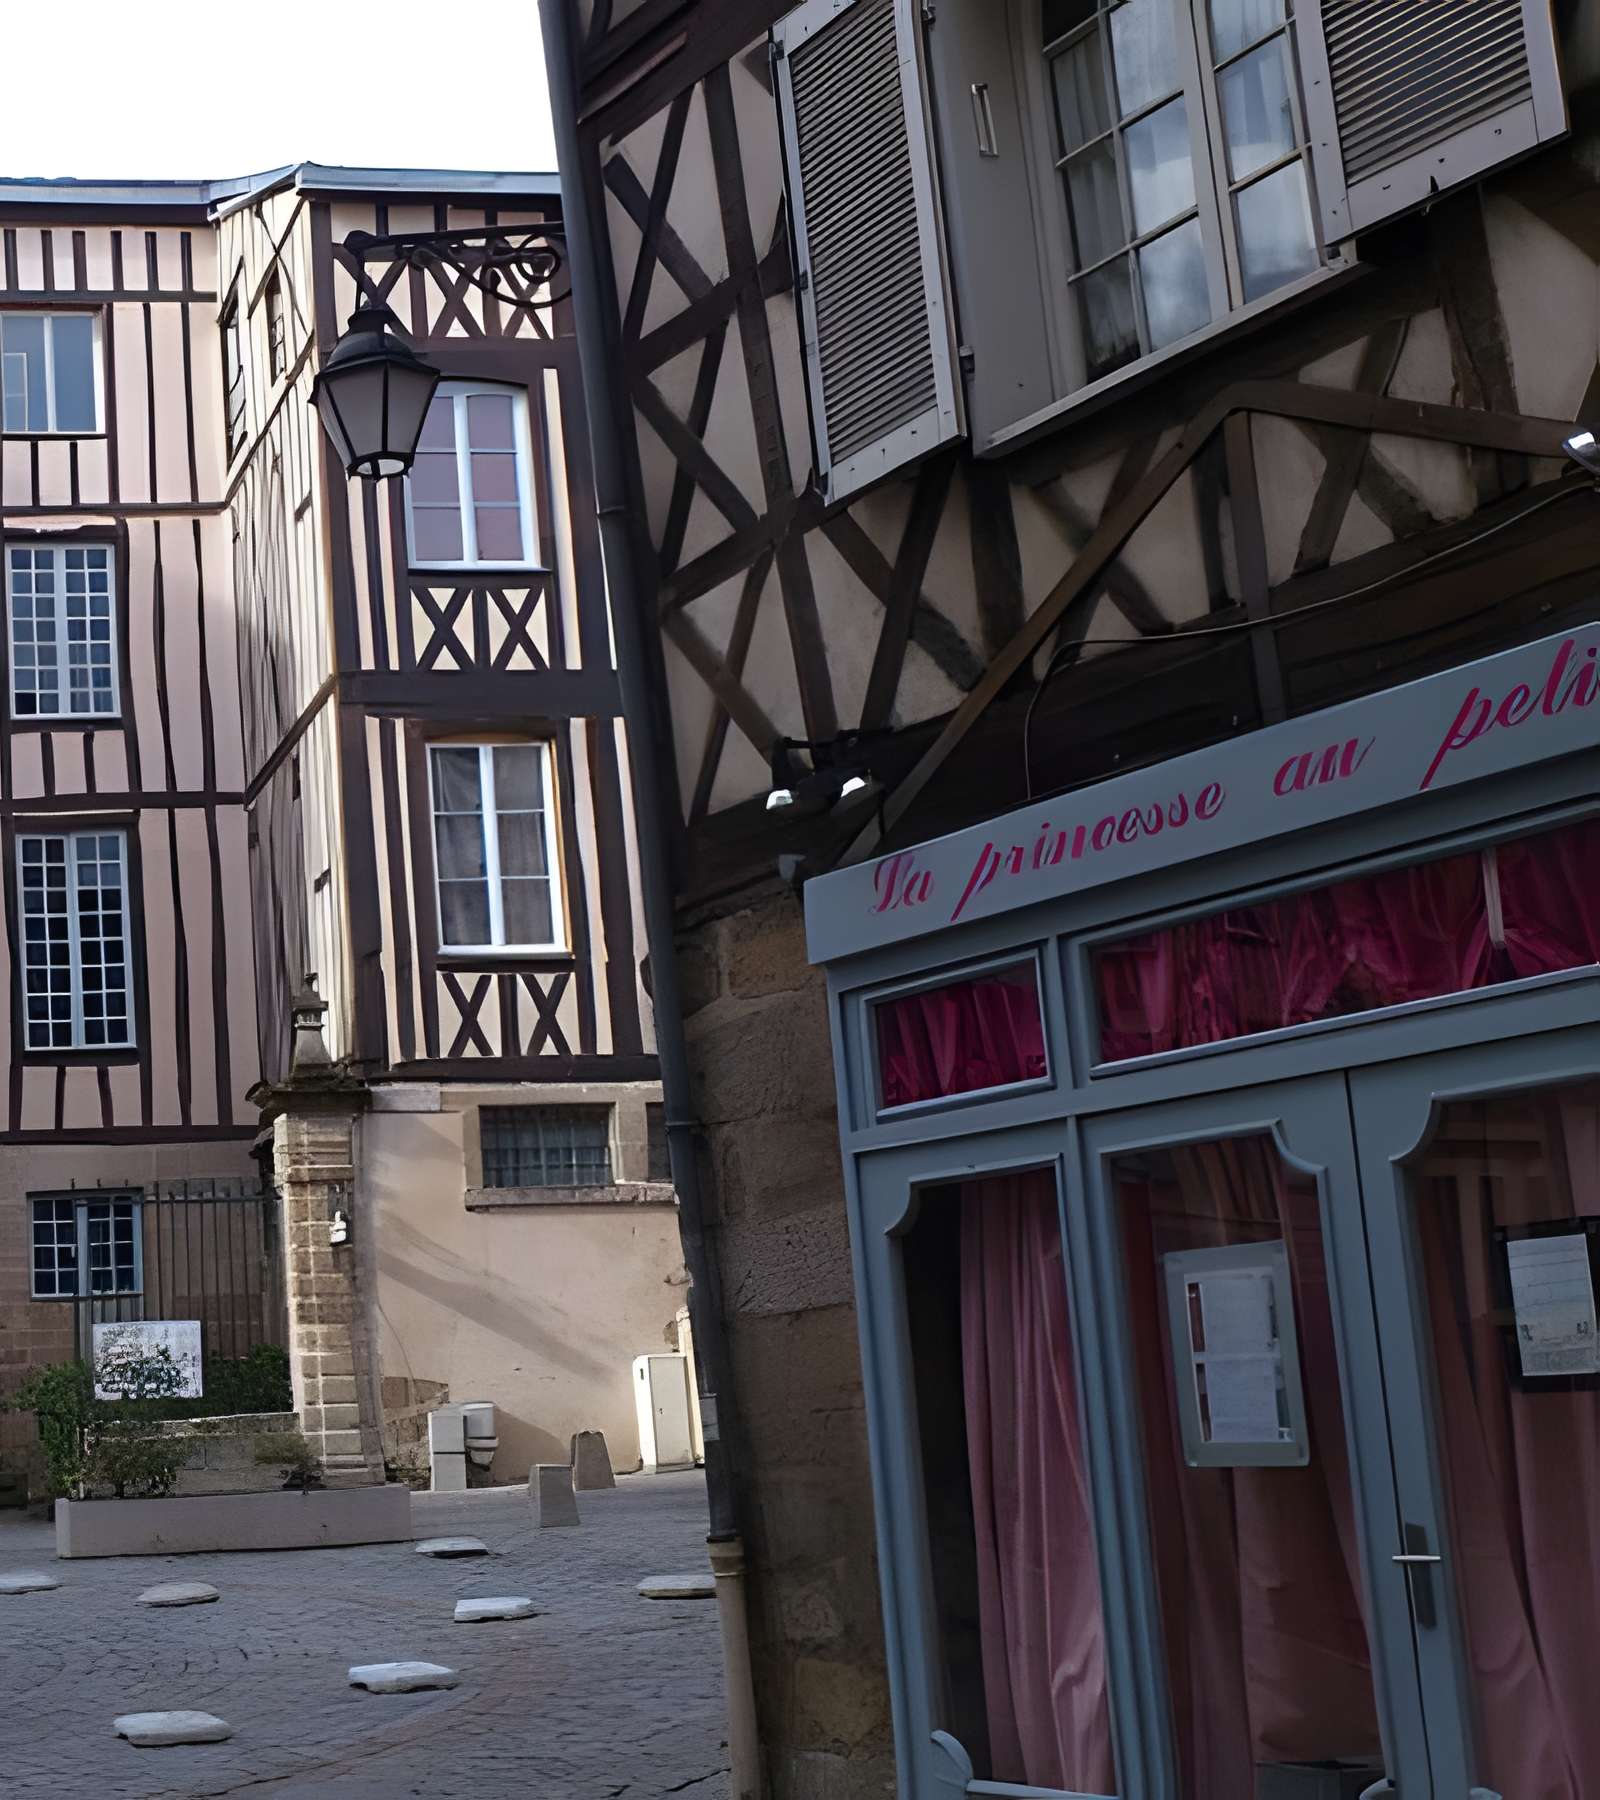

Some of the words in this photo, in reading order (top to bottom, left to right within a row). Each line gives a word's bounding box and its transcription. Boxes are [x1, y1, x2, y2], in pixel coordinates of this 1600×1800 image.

[872, 850, 933, 914] La
[950, 783, 1225, 922] princesse
[1273, 736, 1376, 797] au
